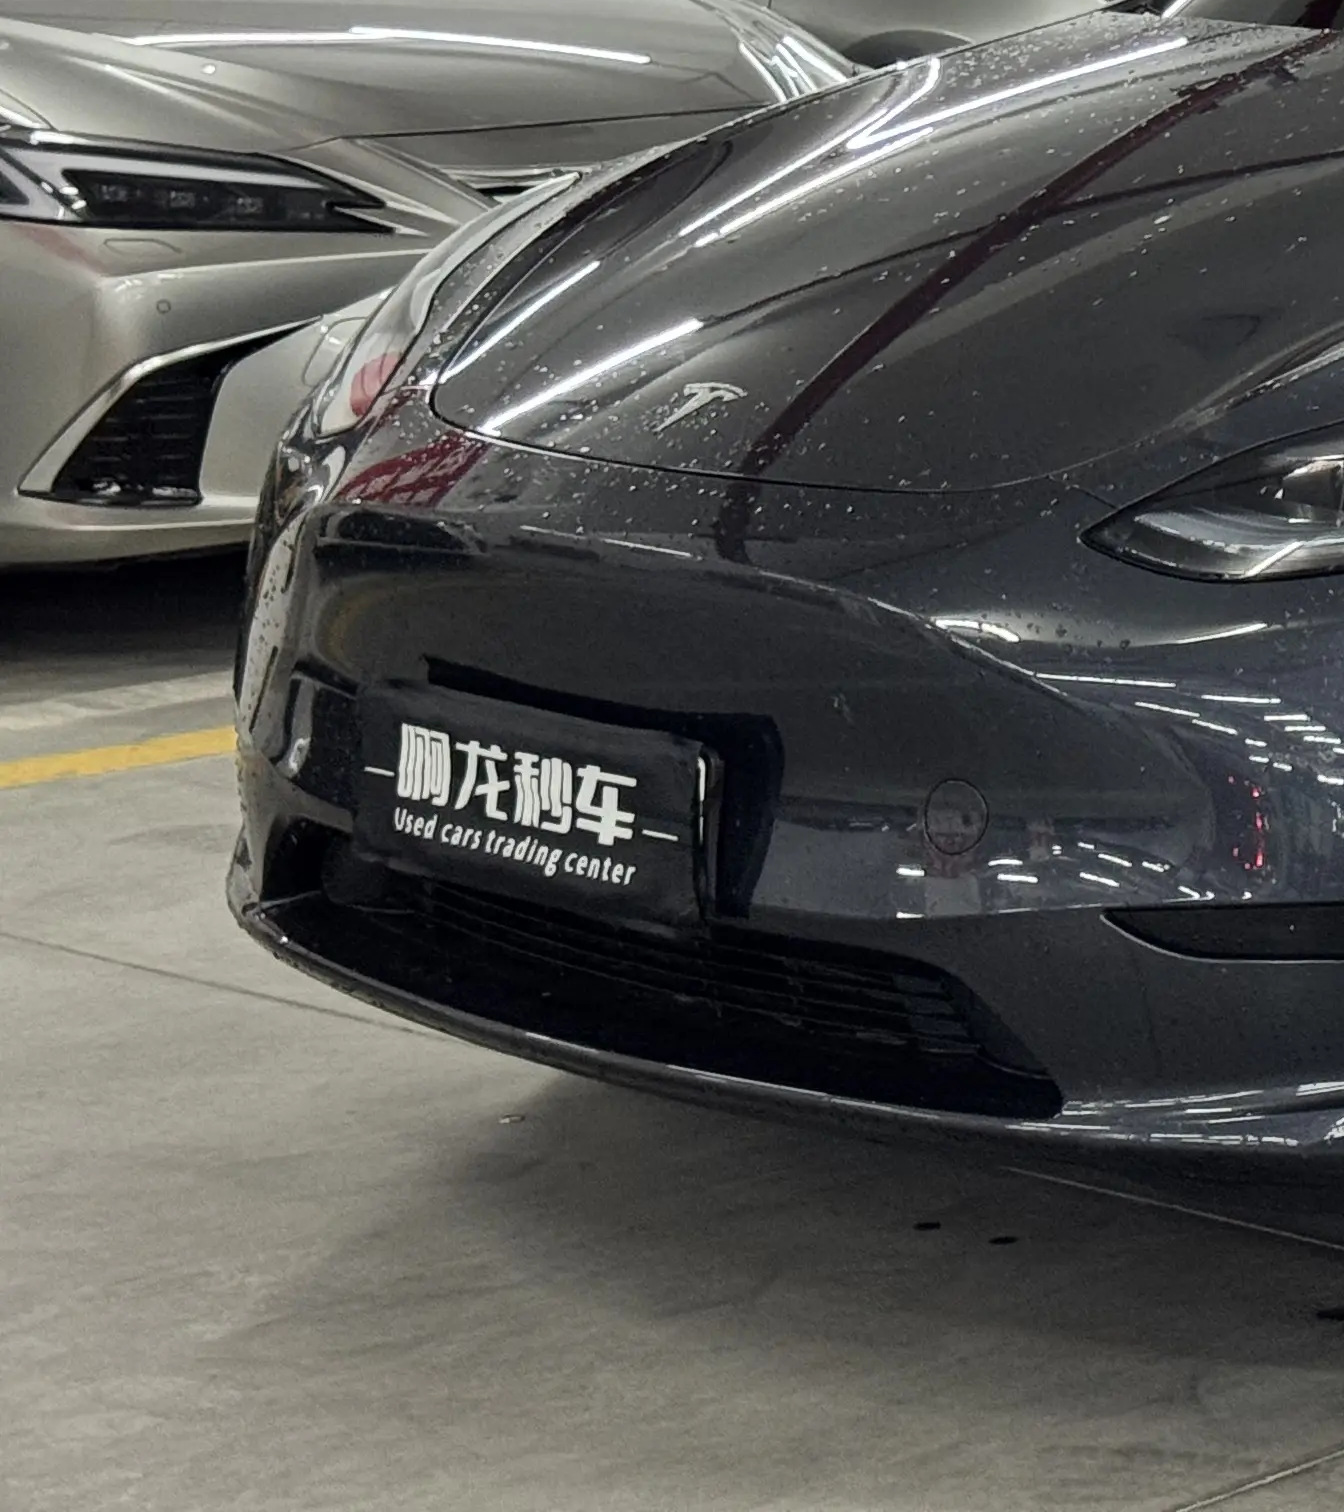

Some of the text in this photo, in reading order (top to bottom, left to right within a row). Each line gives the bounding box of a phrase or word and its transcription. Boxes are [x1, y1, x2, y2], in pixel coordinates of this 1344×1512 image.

[393, 806, 637, 885] Used cars trading center
